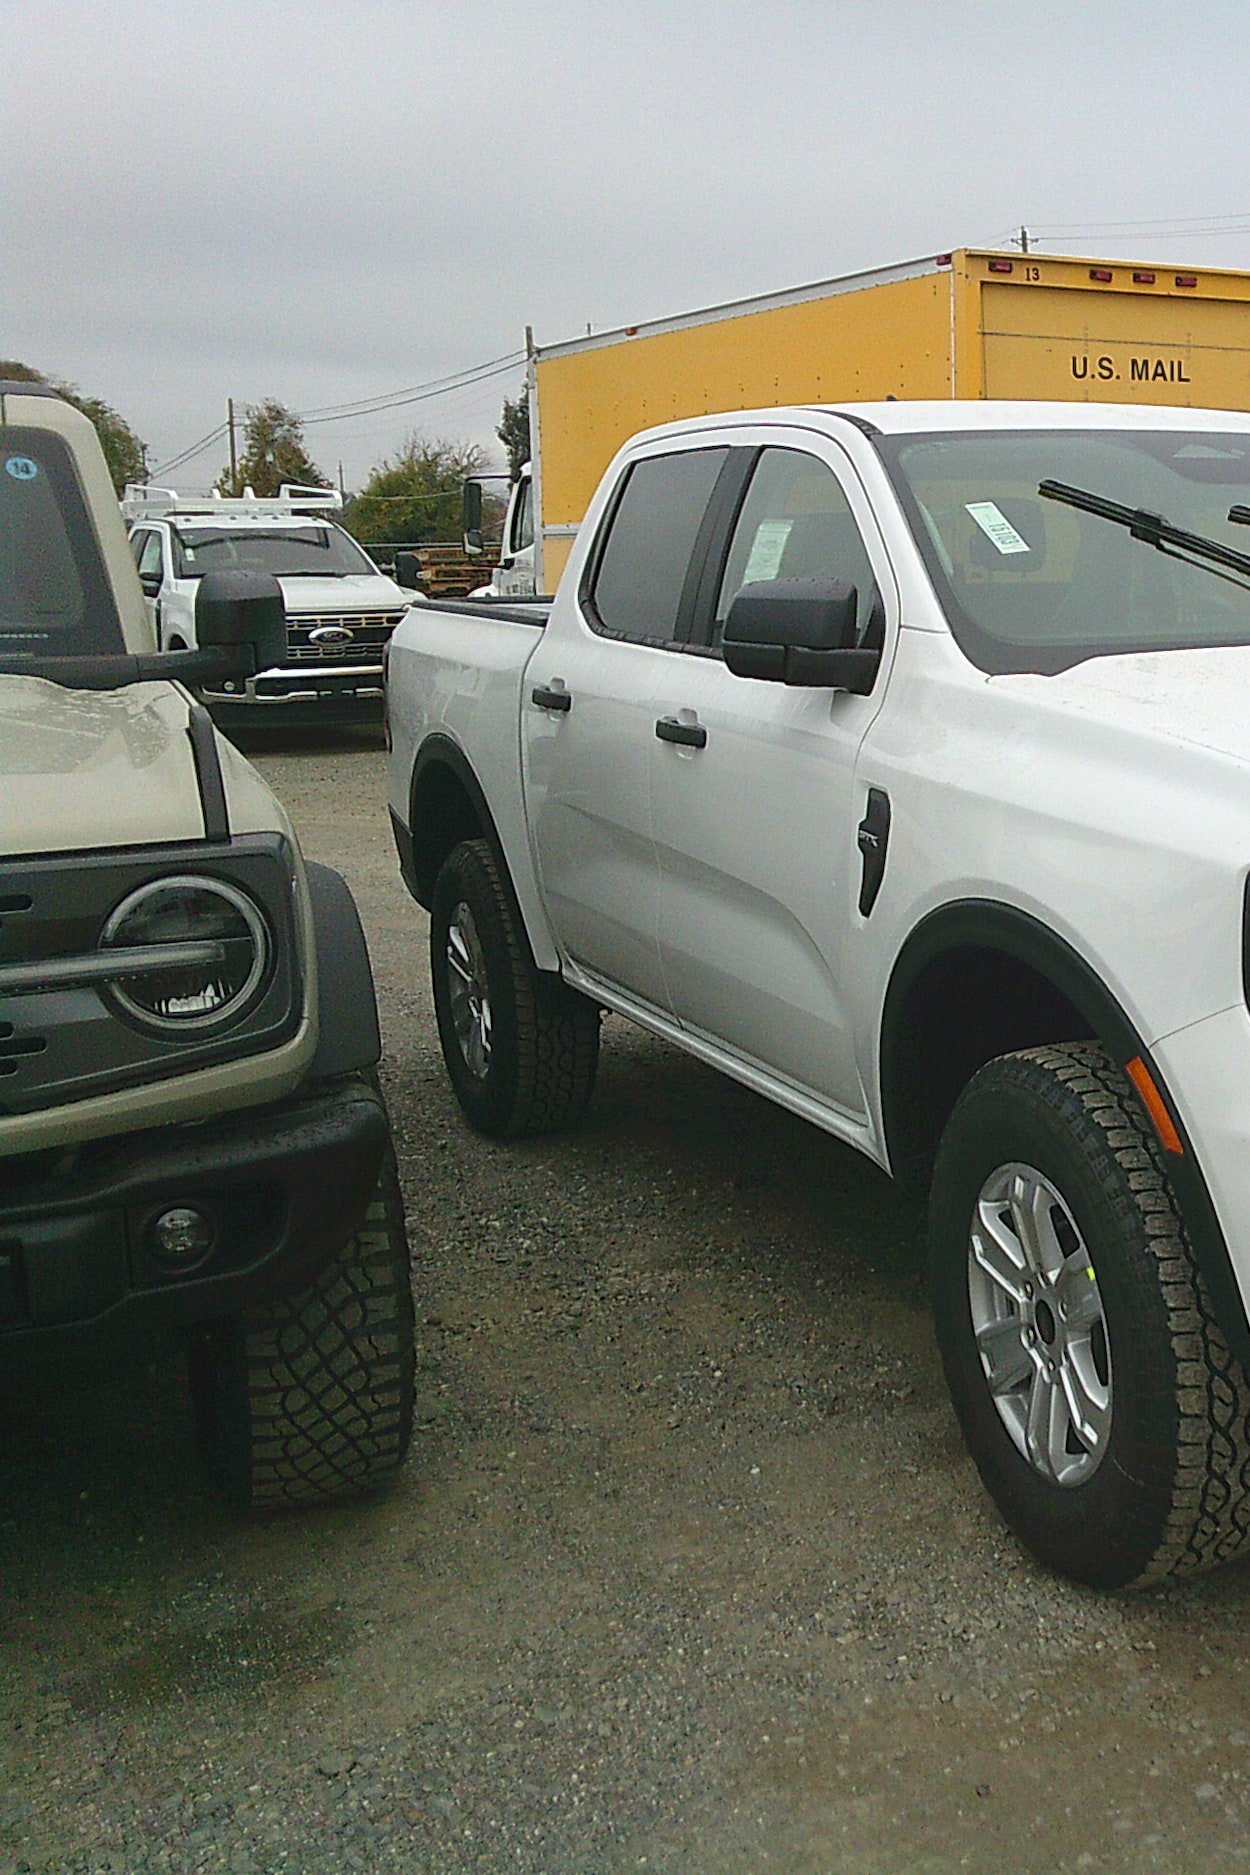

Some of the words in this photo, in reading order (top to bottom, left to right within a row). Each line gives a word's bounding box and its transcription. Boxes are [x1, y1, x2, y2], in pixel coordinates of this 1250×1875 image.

[1025, 267, 1040, 281] 13
[1072, 356, 1120, 380] U.S.
[1130, 358, 1191, 382] MAIL
